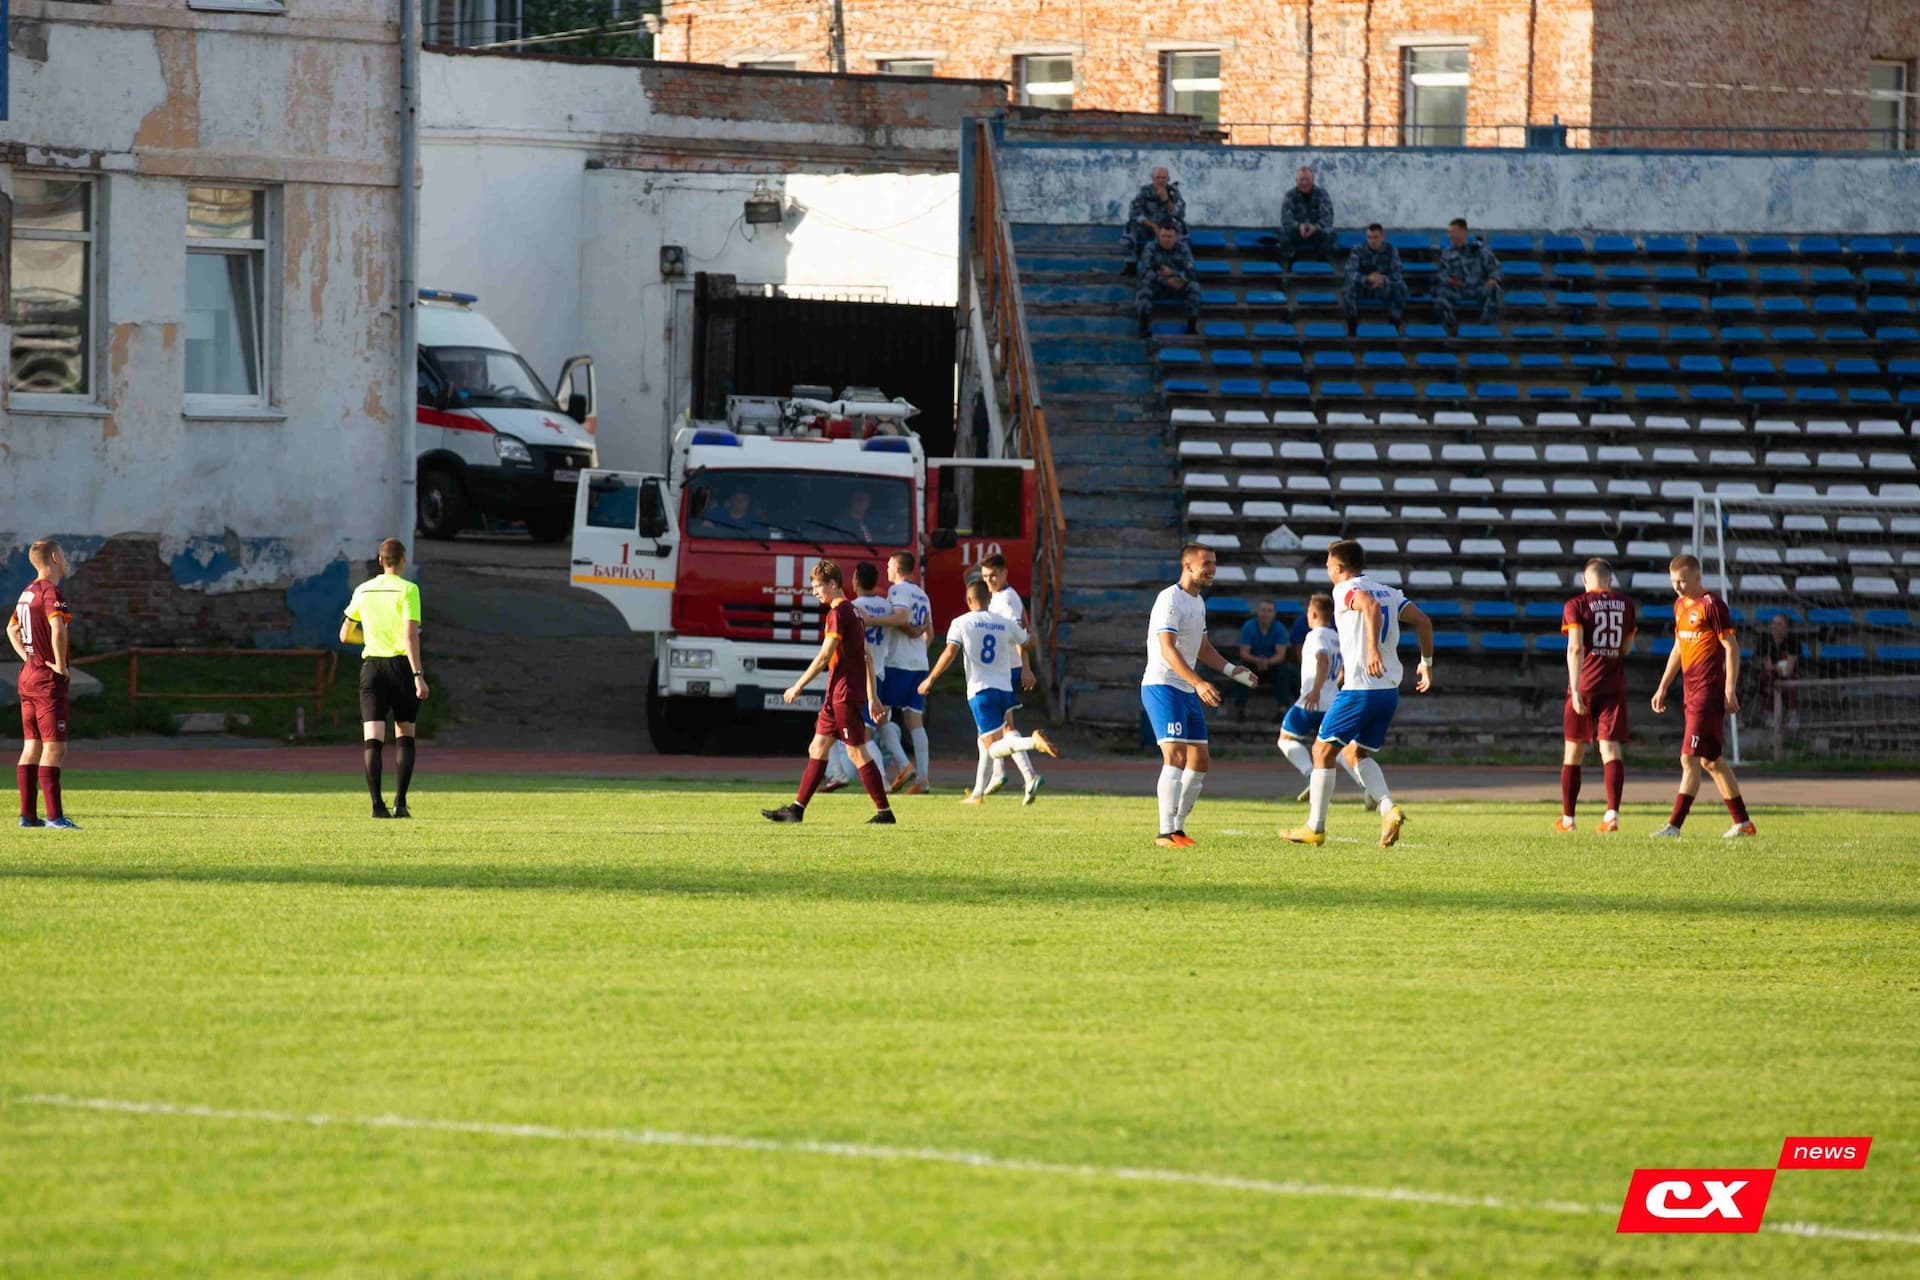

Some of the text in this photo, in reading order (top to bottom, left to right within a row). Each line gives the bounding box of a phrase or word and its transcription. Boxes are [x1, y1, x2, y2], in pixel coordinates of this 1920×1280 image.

[621, 543, 629, 565] 1
[594, 564, 656, 580] БАРНАУЛ
[1592, 611, 1624, 648] 25
[980, 633, 996, 665] 8
[1167, 721, 1182, 736] 49
